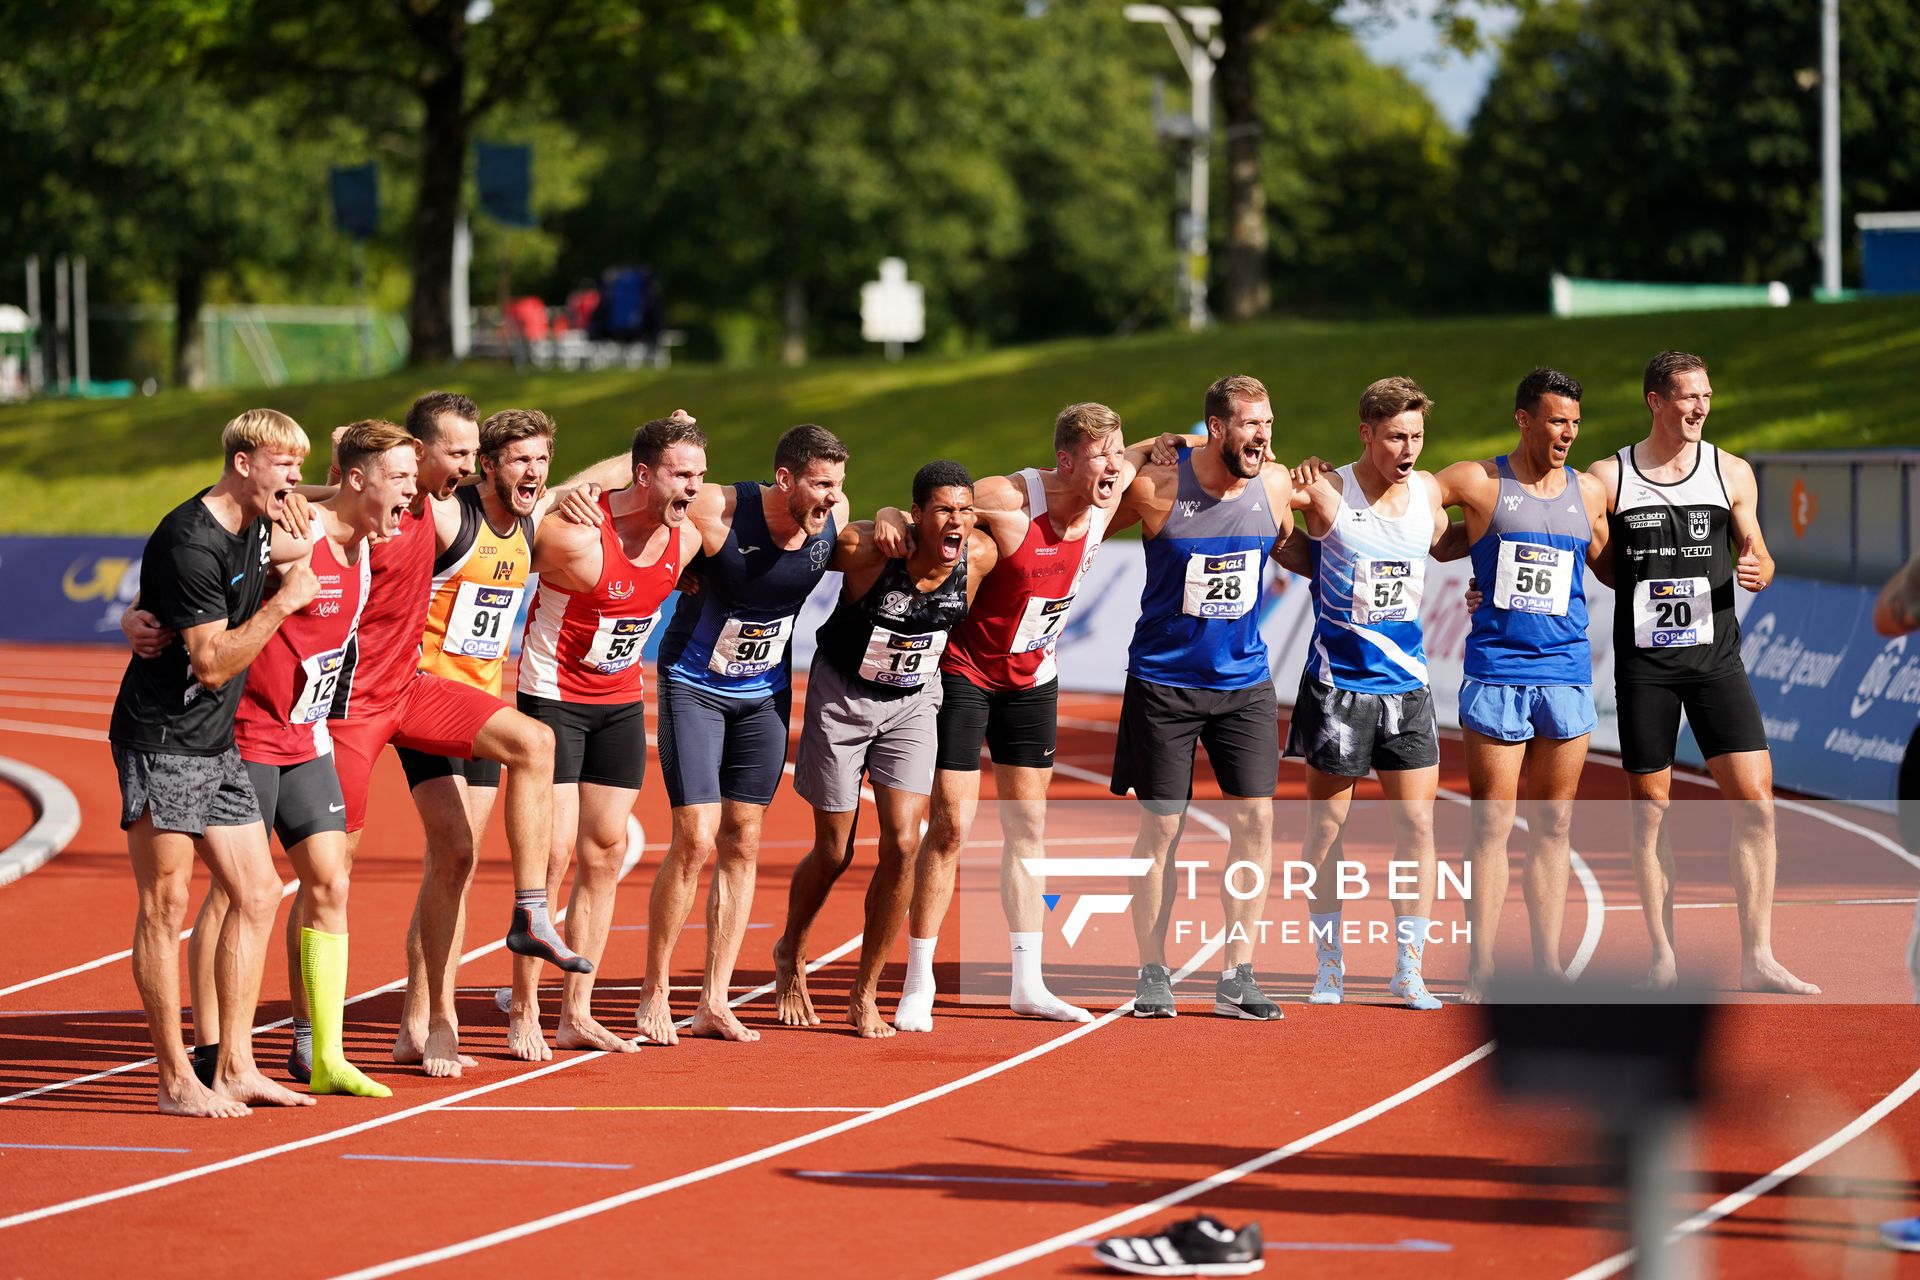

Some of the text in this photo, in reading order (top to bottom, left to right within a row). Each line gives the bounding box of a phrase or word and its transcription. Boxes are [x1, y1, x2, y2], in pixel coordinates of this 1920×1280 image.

[1538, 552, 1556, 562] GLS
[1660, 548, 1676, 556] UNO
[1682, 547, 1711, 556] TEVA
[1226, 559, 1243, 569] GLS
[1392, 566, 1409, 576] GLS
[1516, 567, 1552, 595] 56
[1206, 575, 1241, 600] 28
[1673, 585, 1691, 595] GLS
[1374, 580, 1403, 607] 52
[496, 594, 511, 605] GLS
[1528, 598, 1552, 608] PLAN
[1218, 604, 1243, 612] PLAN
[1656, 602, 1692, 628] 20
[472, 610, 501, 638] 91
[634, 622, 649, 632] GLS
[1043, 614, 1061, 634] 7
[763, 625, 779, 636] GLS
[1670, 632, 1695, 640] PLAN
[478, 642, 499, 653] PLAN
[606, 637, 640, 660] 55
[911, 639, 930, 649] GLS
[735, 641, 770, 661] 90
[744, 663, 768, 671] PLAN
[889, 653, 922, 673] 19
[312, 676, 336, 704] 12
